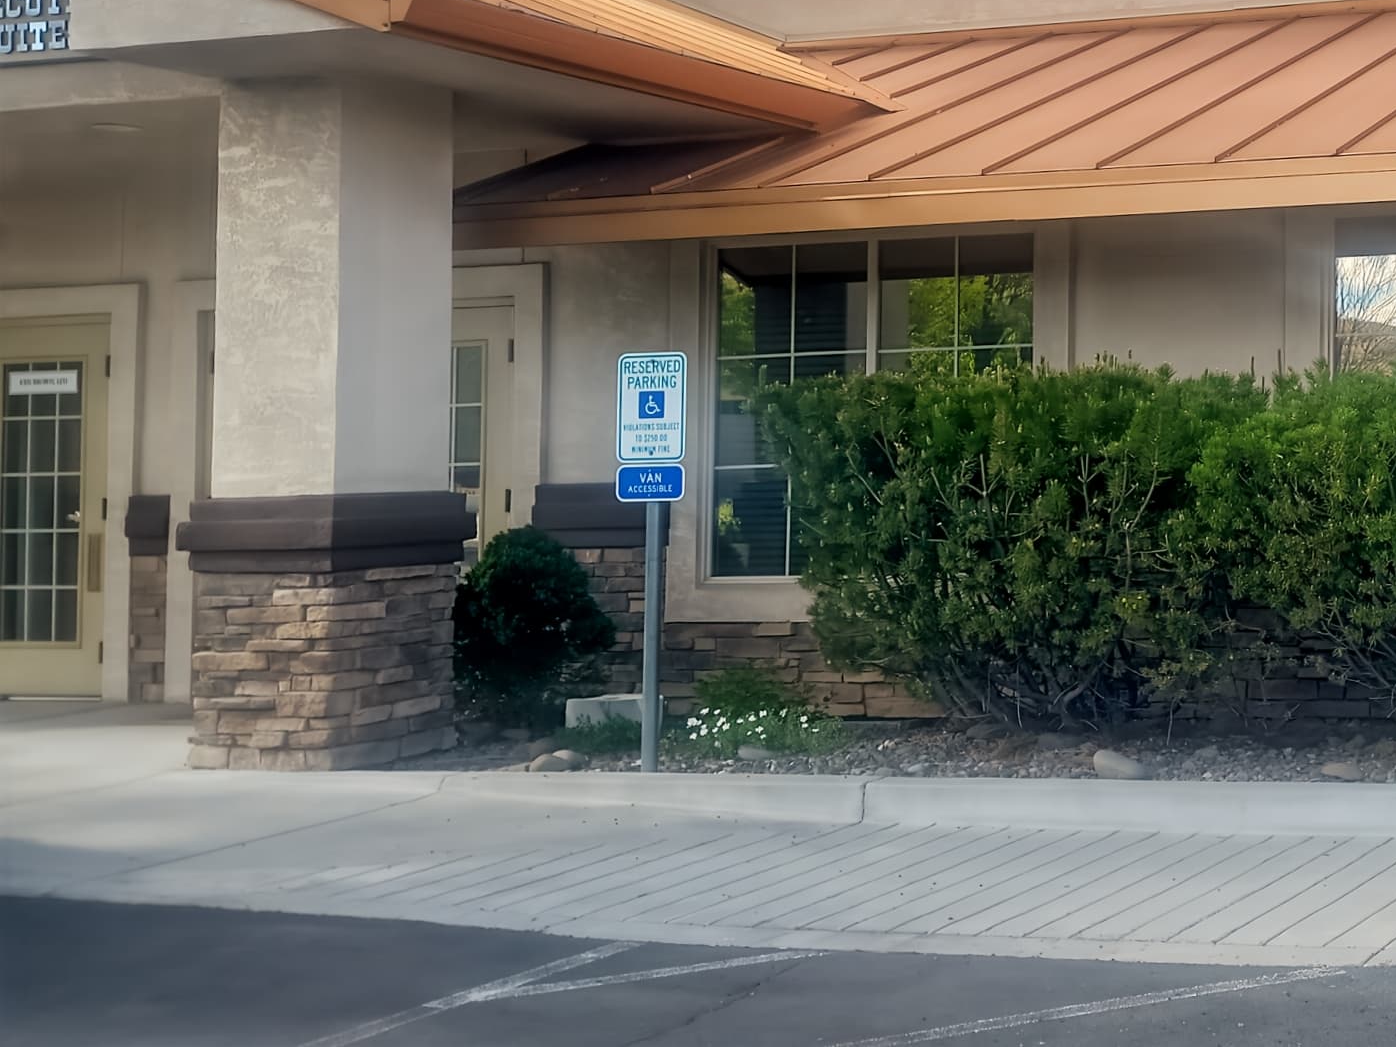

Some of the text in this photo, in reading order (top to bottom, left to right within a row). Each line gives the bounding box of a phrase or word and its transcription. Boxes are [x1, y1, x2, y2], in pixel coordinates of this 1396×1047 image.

[624, 359, 681, 375] RESERVED
[627, 375, 677, 390] PARKING
[623, 422, 680, 432] VIOLATIONS SUBJECT
[635, 434, 643, 443] TO
[639, 472, 662, 484] VAN
[628, 484, 673, 494] ACCESSIBLE
